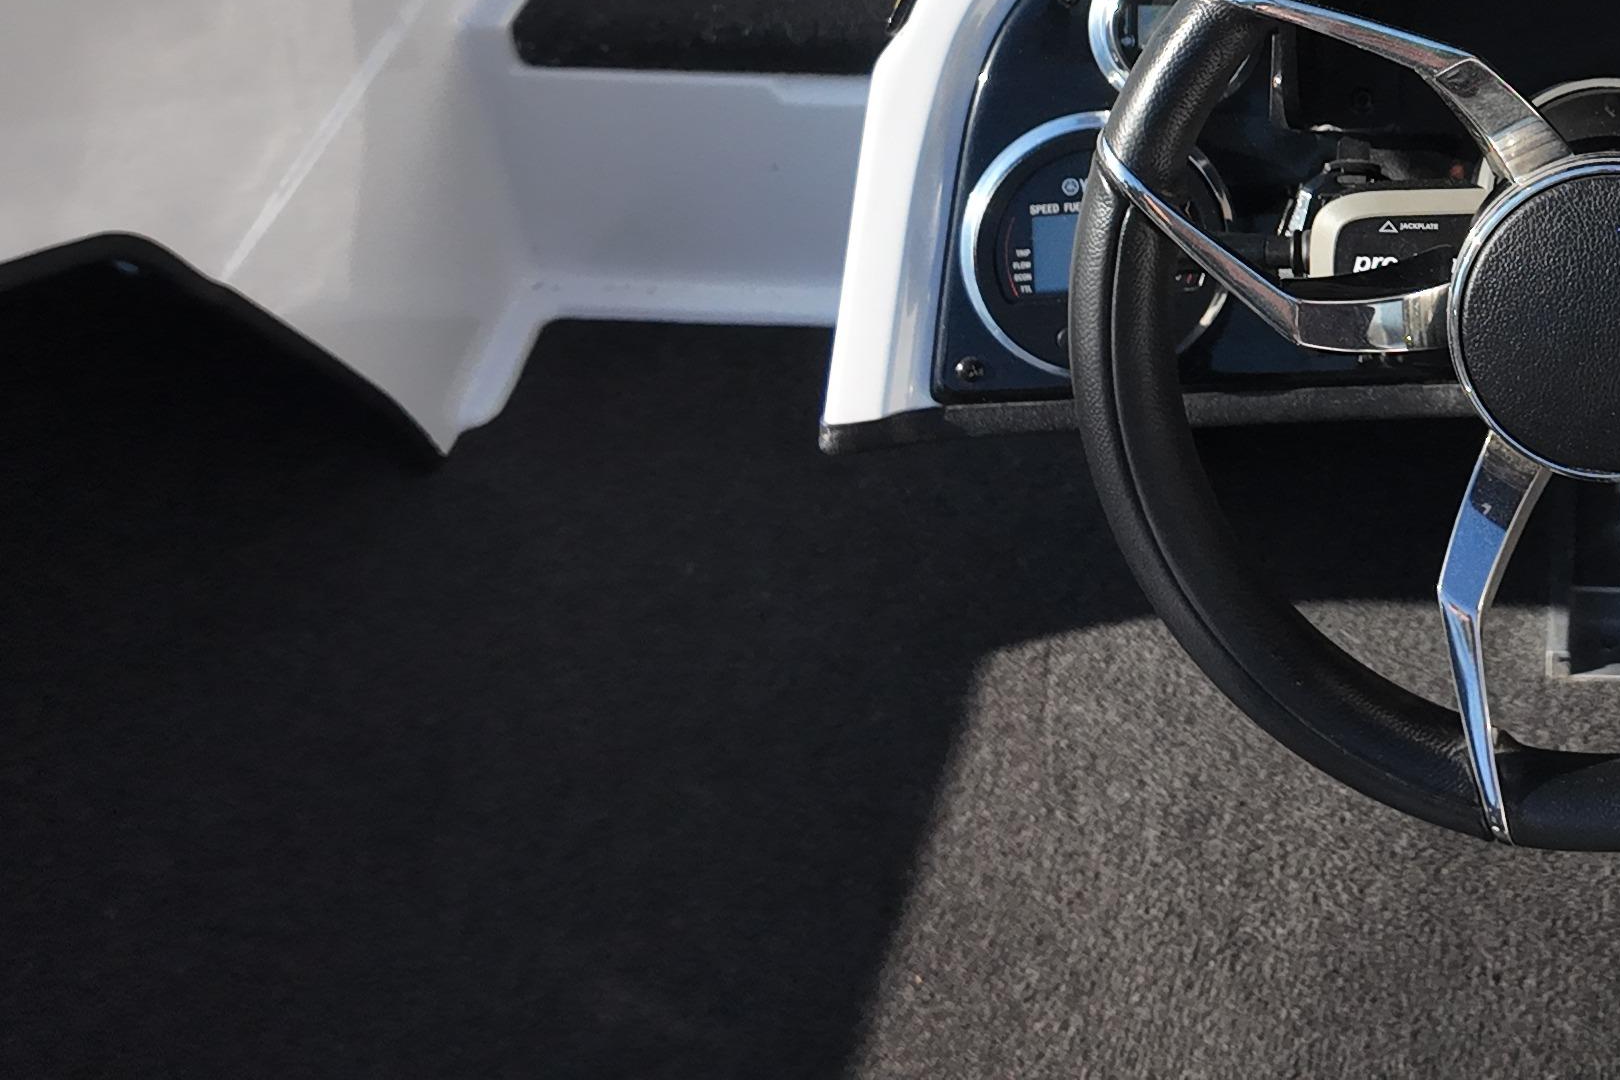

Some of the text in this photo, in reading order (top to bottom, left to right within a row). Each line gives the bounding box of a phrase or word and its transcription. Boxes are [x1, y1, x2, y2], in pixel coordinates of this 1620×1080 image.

[1029, 202, 1081, 216] SPEED FUE
[1400, 222, 1438, 231] JACKPLATE
